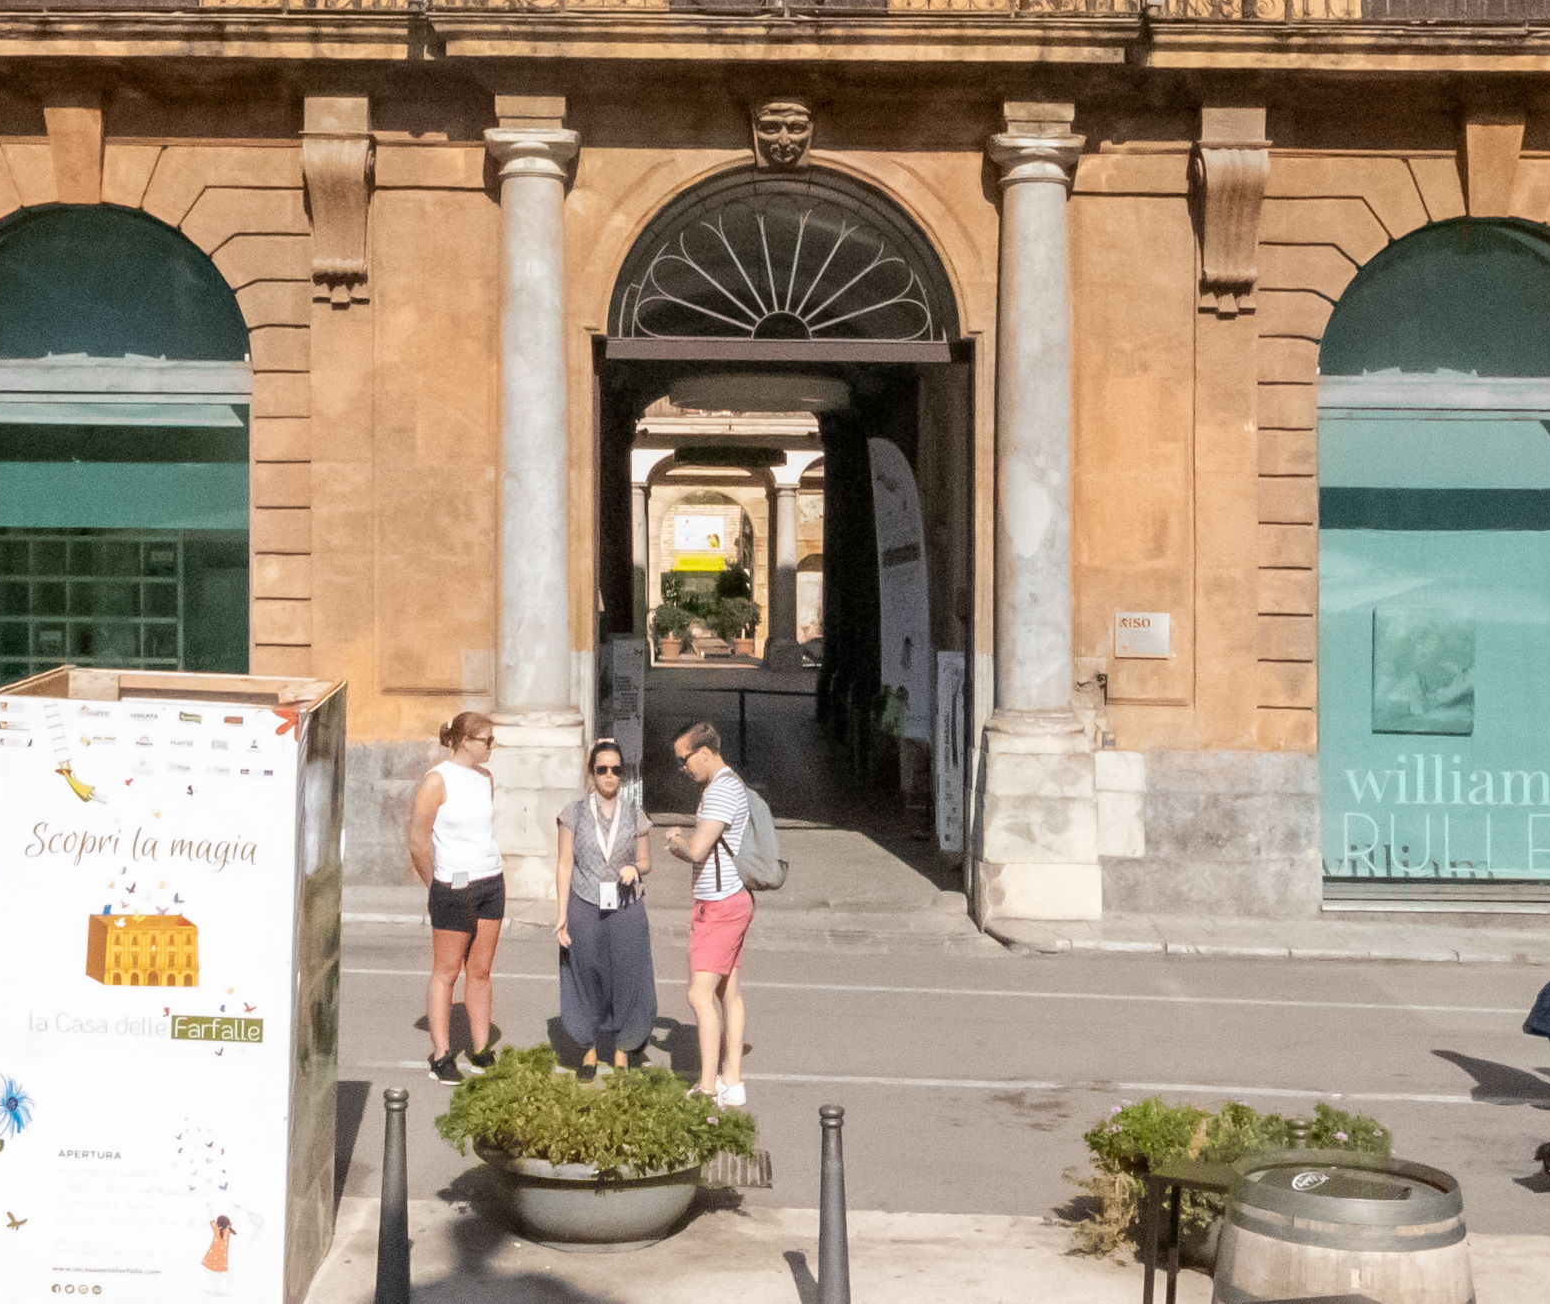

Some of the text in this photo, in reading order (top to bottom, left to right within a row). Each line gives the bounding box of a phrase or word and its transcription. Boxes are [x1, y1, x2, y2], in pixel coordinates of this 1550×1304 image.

[24, 822, 259, 872] Scopri la magia
[28, 1011, 262, 1042] la Casa delle Farfalle
[57, 1148, 122, 1161] APERTURA
